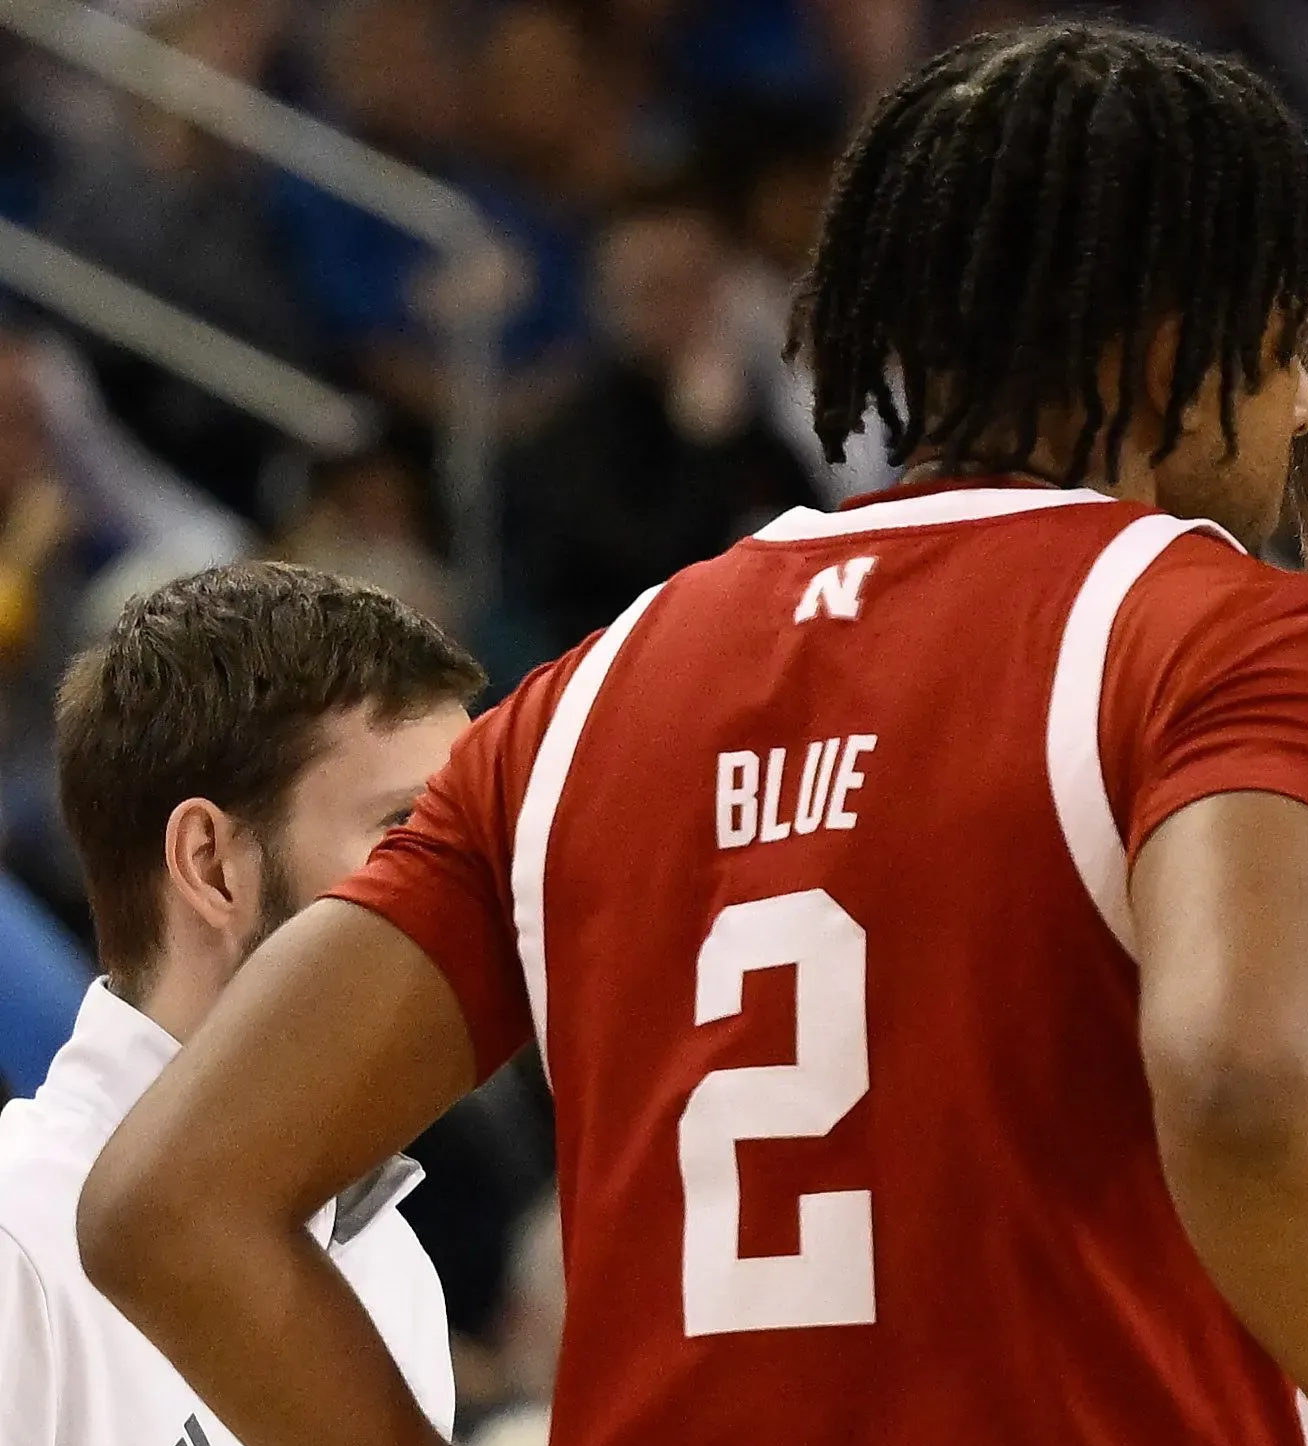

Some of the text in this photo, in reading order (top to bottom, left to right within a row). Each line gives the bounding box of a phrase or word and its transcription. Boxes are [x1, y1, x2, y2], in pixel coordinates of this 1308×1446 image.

[793, 555, 880, 626] N
[715, 734, 878, 850] BLUE
[678, 887, 876, 1338] 2
